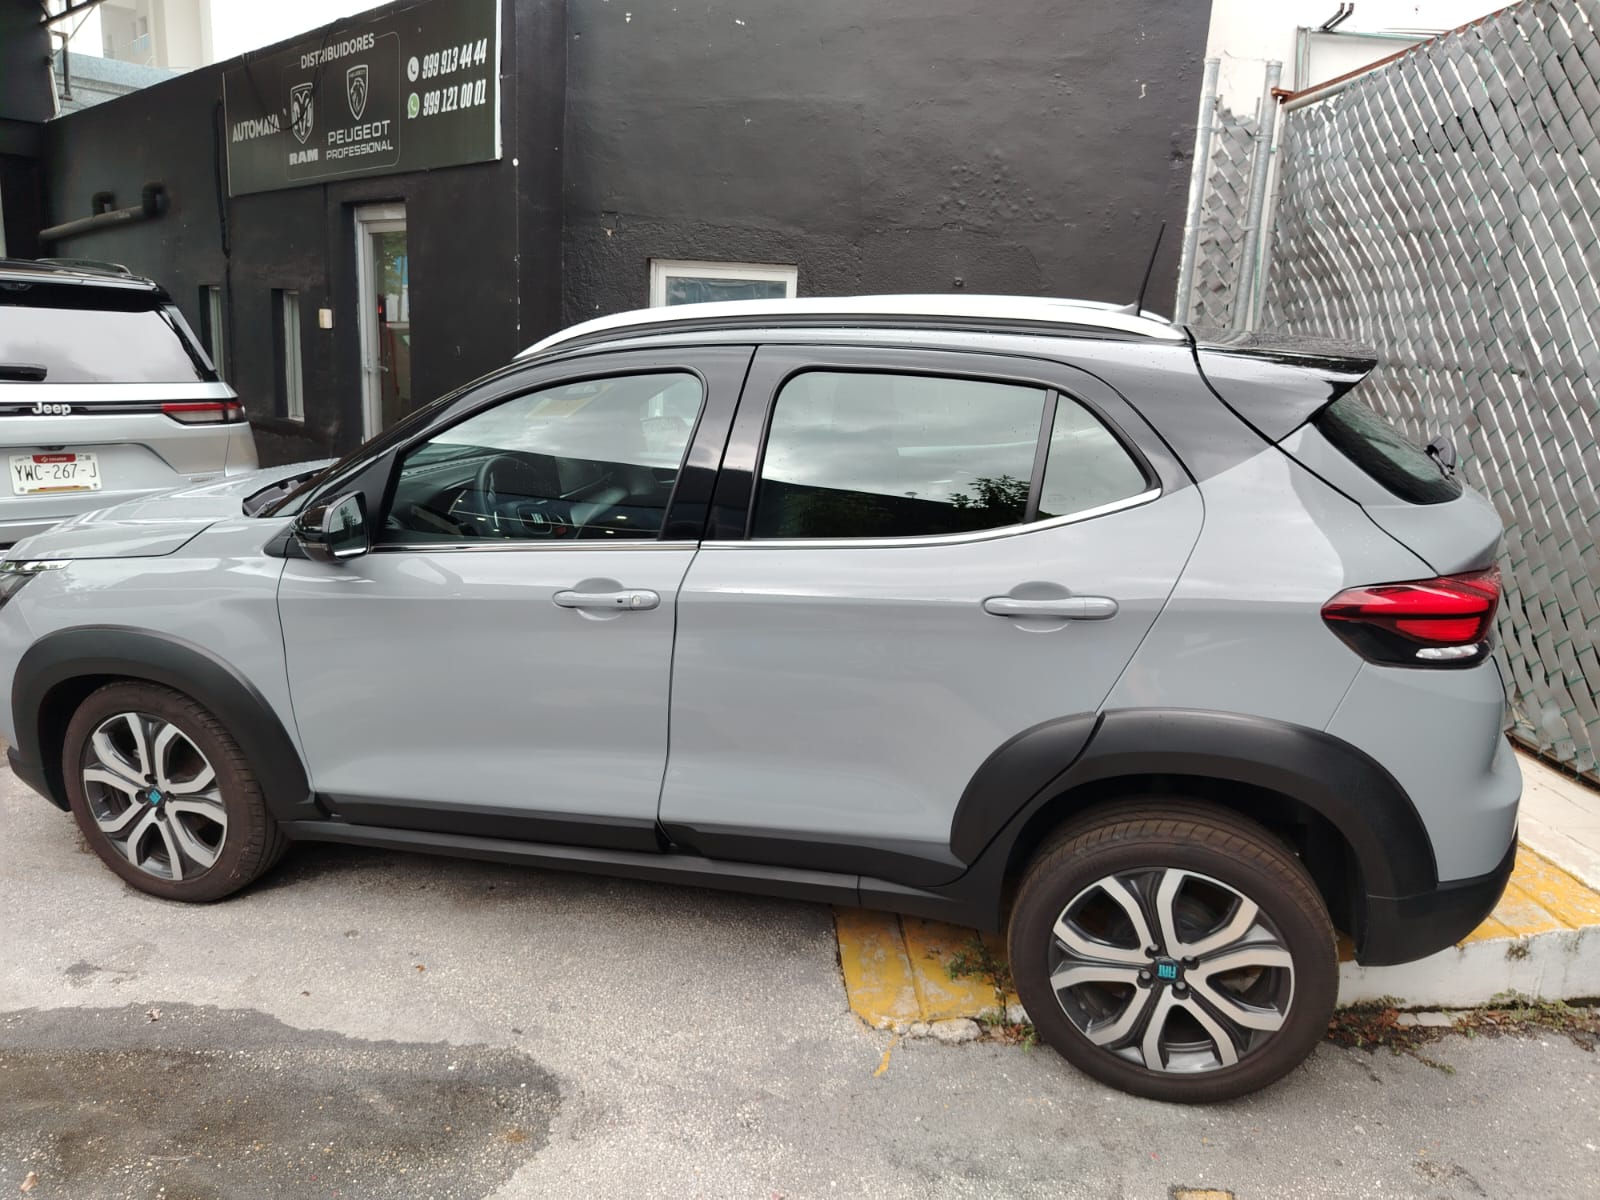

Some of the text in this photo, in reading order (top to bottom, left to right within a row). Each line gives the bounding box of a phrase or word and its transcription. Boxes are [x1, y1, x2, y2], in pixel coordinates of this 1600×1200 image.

[301, 33, 375, 69] DISTRIBUIDORES
[422, 38, 488, 79] 999 913 44 44
[423, 79, 487, 117] 999 121 00 01
[232, 114, 280, 143] AUTOMAYA
[328, 120, 391, 145] PEUGEOT
[289, 148, 319, 165] RAM
[326, 140, 394, 161] PROFESSIONAL
[32, 402, 72, 416] Jeep
[15, 462, 97, 481] YWC-267-J
[1158, 964, 1176, 978] FIAT
